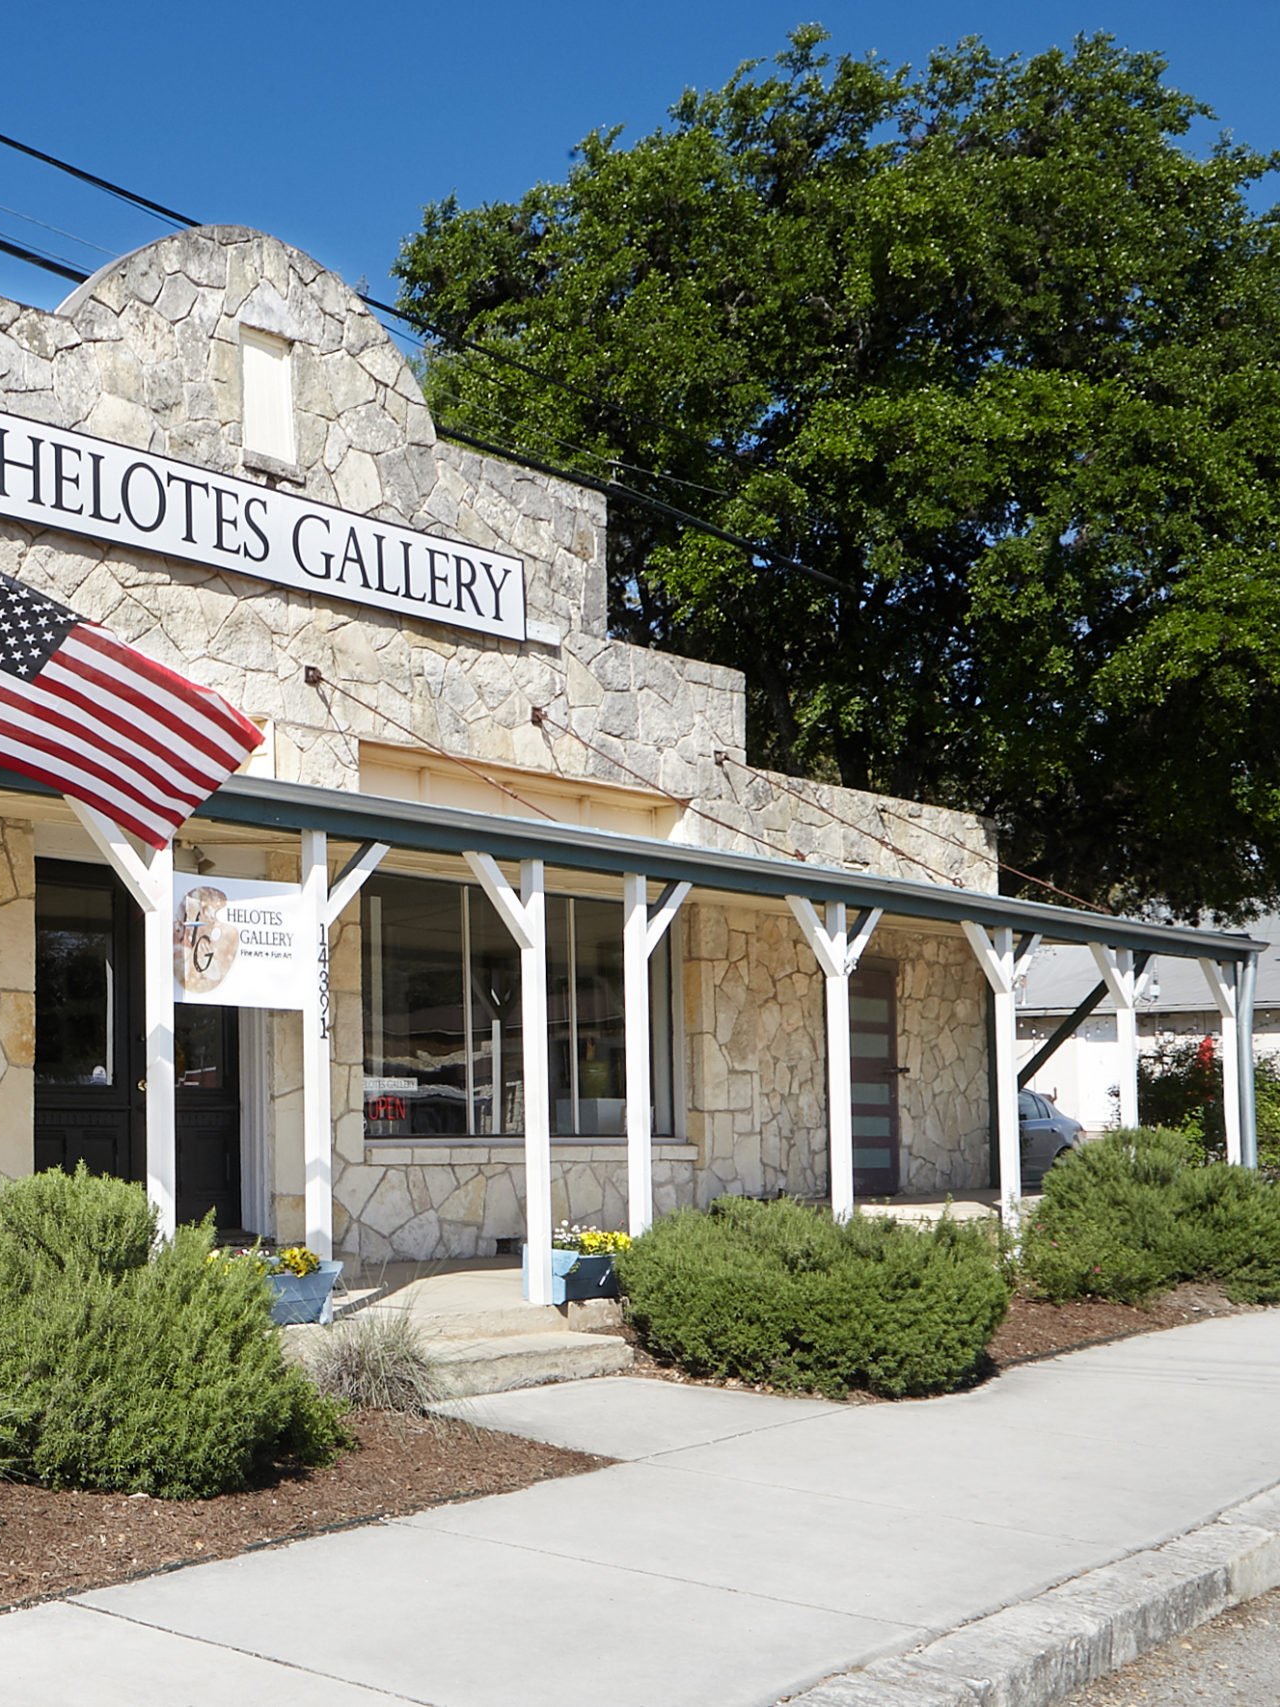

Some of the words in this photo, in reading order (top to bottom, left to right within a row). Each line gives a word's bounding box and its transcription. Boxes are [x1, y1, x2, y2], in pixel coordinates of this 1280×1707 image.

[292, 513, 512, 622] GALLERY
[226, 908, 283, 926] HELOTES
[240, 929, 294, 947] GALLERY
[240, 949, 253, 957] Fine
[317, 922, 329, 1040] 14391
[368, 1096, 406, 1120] OPEN
